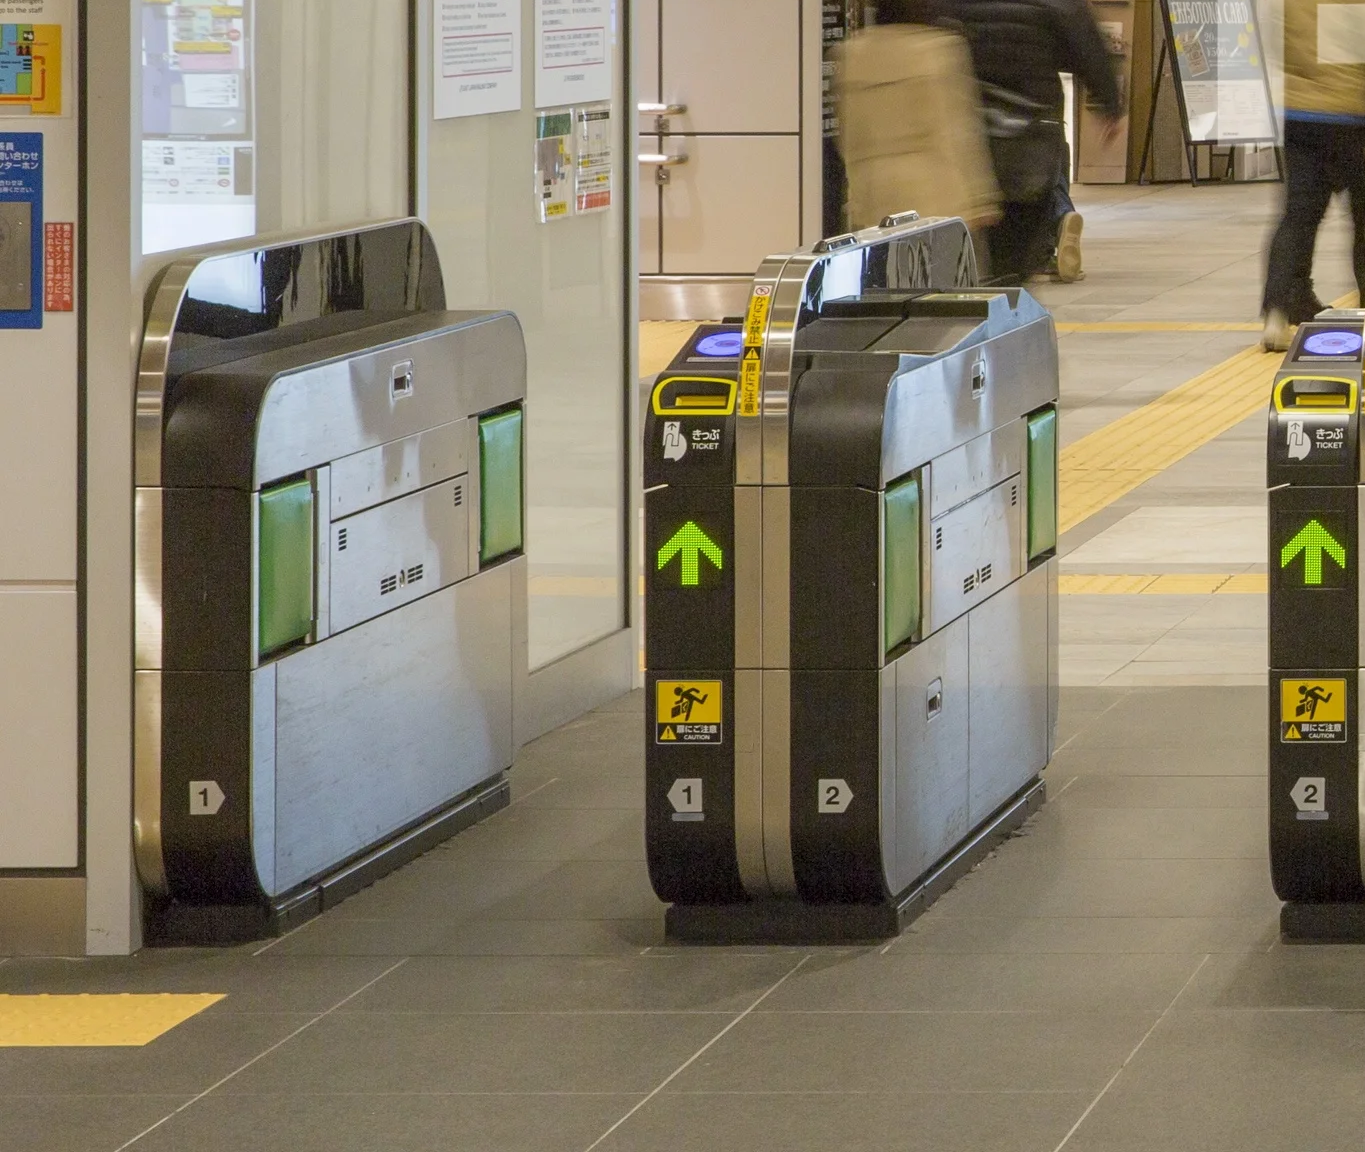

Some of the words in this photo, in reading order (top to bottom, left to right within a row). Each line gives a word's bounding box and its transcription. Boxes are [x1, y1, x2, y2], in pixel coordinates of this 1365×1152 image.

[742, 362, 758, 414] 扉にご注意
[692, 428, 720, 441] きっぷ
[1316, 428, 1343, 441] きっぷ
[692, 442, 719, 450] TICKET
[1316, 441, 1343, 449] TICKET
[676, 725, 717, 734] 扉にご注意
[1301, 723, 1342, 733] 扉にご注意
[198, 787, 209, 806] 1
[681, 786, 693, 805] 1
[826, 786, 840, 805] 2
[1304, 785, 1317, 804] 2
